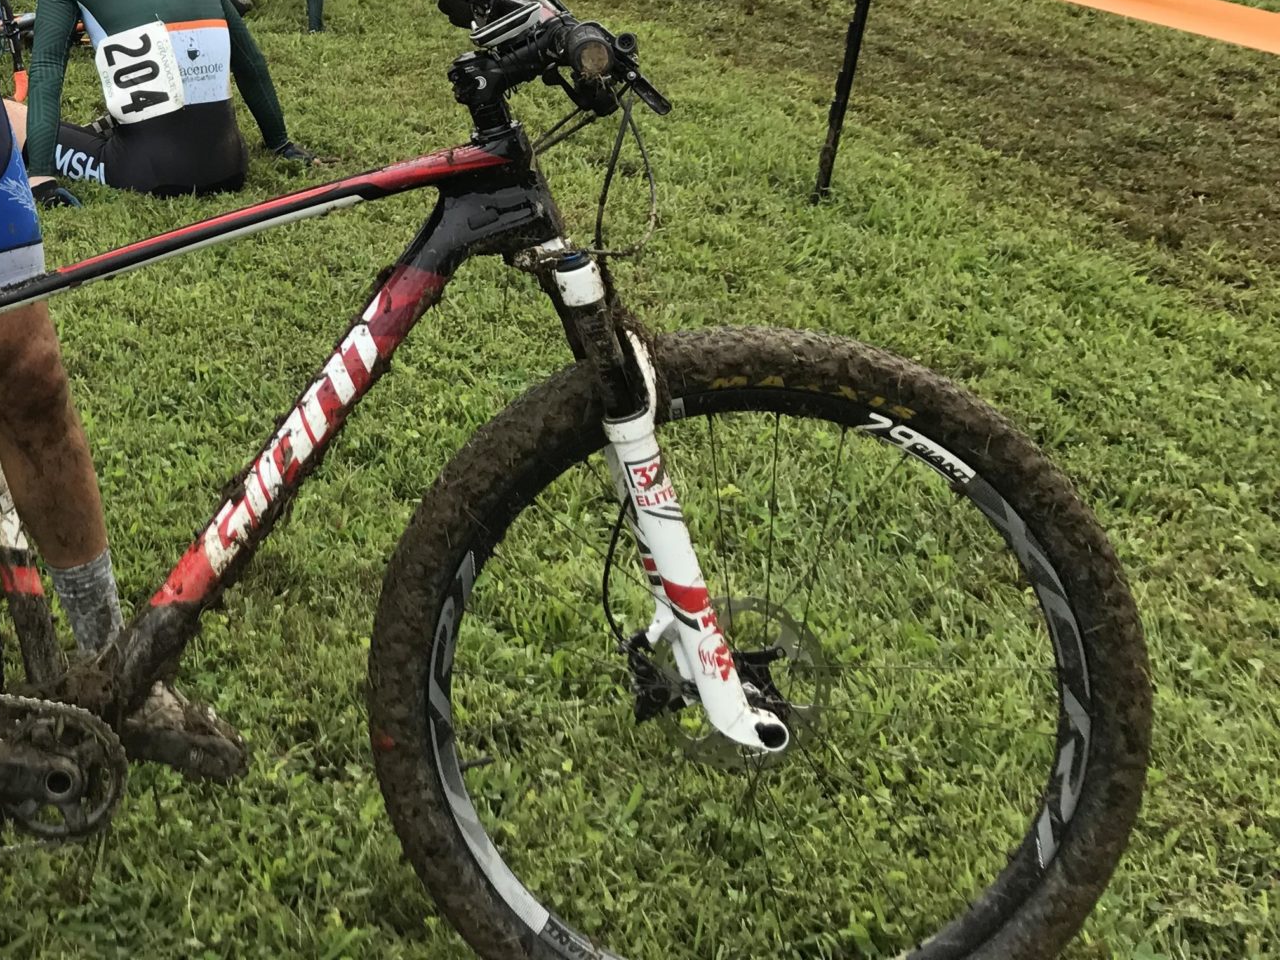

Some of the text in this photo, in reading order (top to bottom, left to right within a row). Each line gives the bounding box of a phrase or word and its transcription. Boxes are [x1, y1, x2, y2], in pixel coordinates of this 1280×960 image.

[103, 33, 170, 115] 204
[909, 442, 971, 484] GIANT
[635, 485, 675, 507] ELITE
